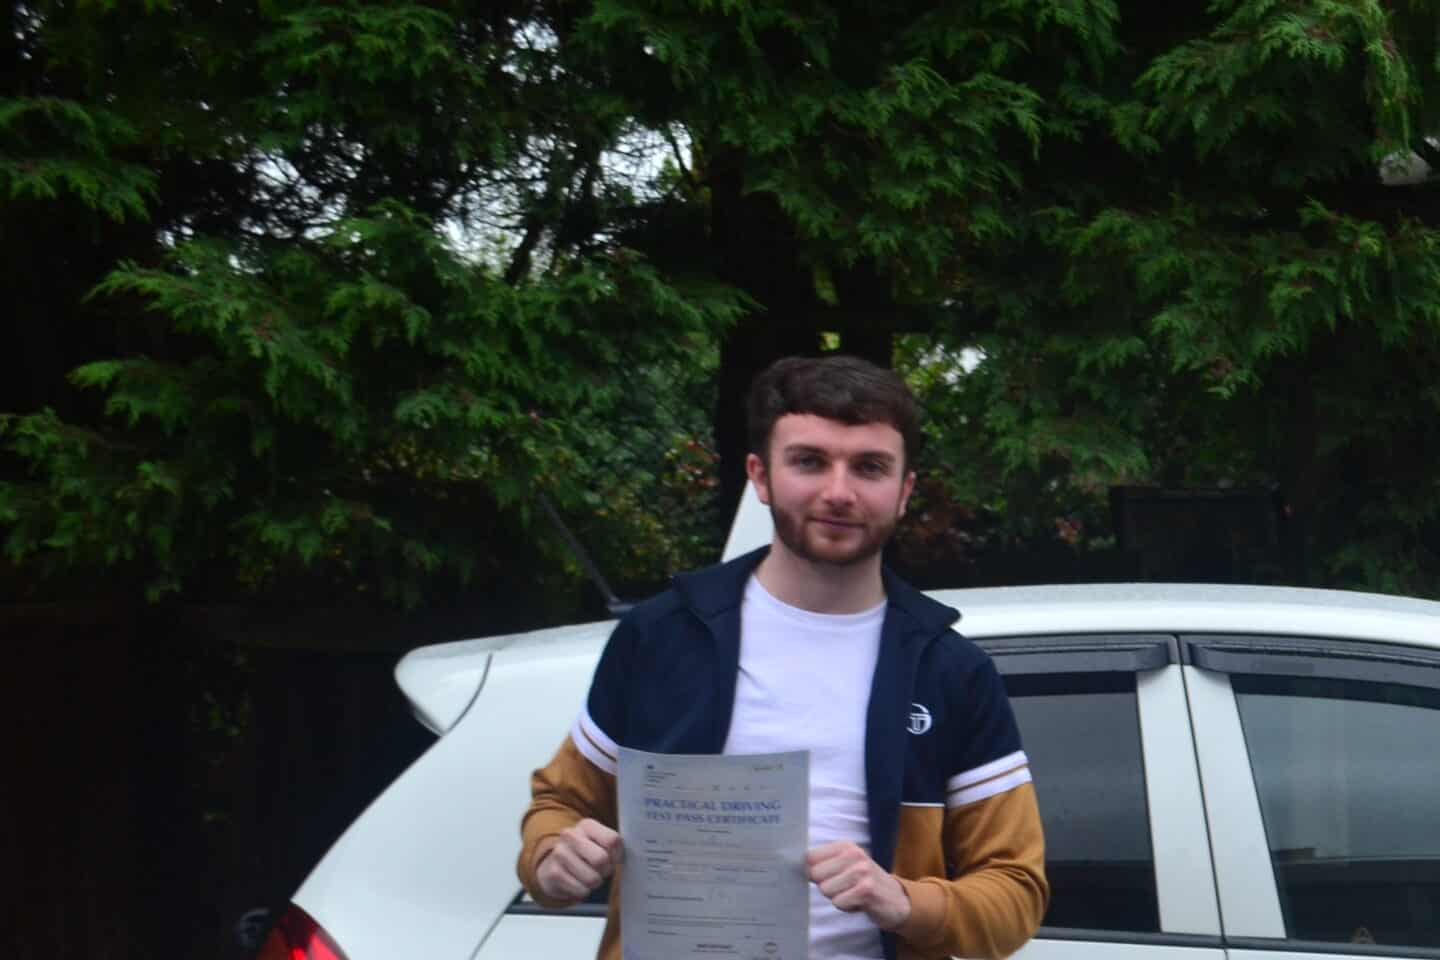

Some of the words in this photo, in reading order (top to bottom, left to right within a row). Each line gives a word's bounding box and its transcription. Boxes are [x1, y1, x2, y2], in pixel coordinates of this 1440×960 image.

[645, 798, 716, 811] PRACTICAL
[721, 800, 781, 811] DRIVING
[646, 811, 671, 822] TEST
[676, 813, 704, 823] PASS
[707, 814, 780, 825] CERTIFICATE
